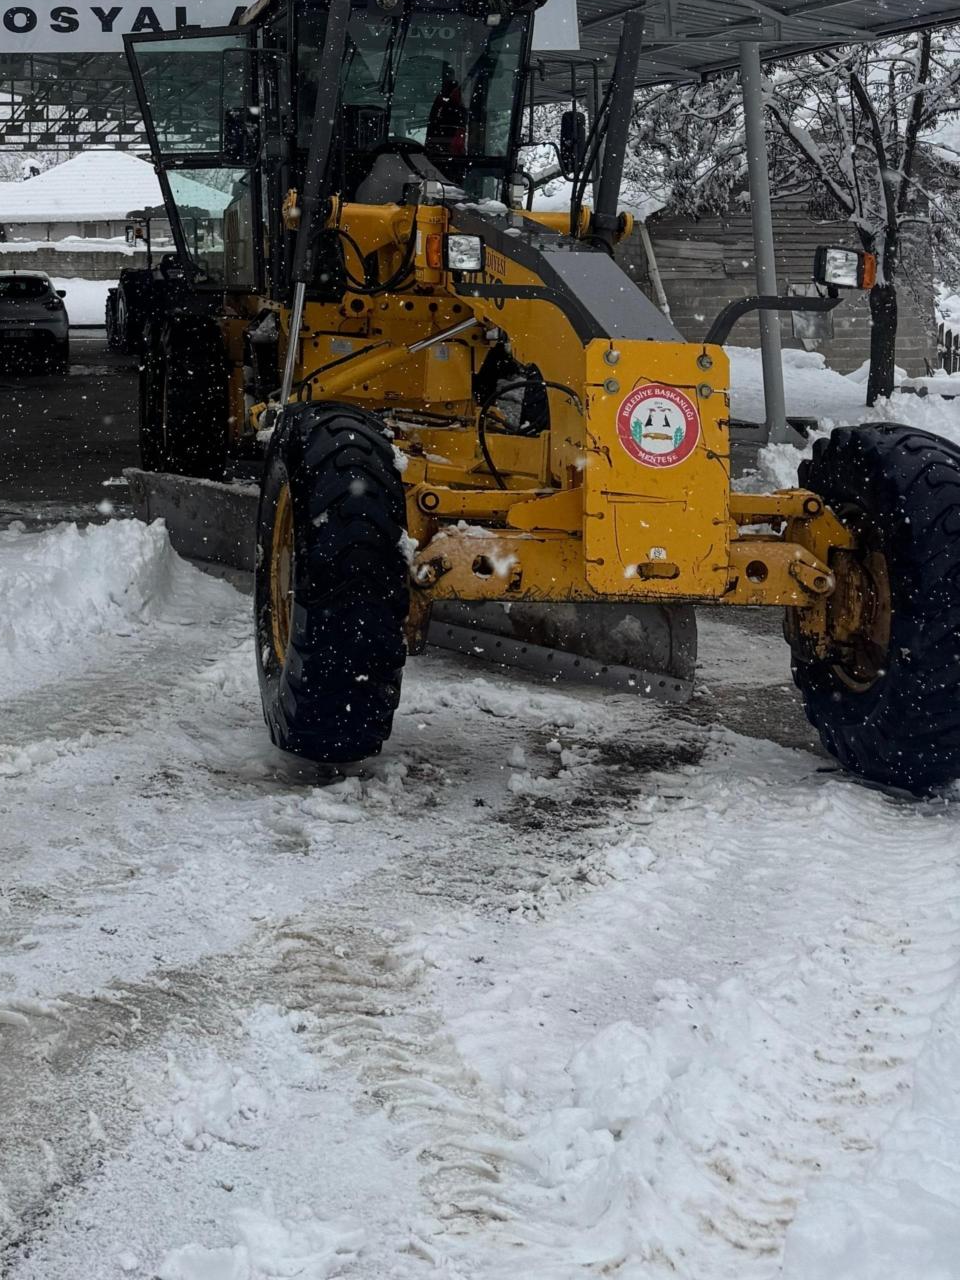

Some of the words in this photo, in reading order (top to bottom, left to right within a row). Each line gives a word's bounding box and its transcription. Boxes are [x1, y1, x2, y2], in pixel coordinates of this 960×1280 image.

[486, 250, 506, 276] DİYESİ
[623, 389, 654, 417] BELEDİYE
[638, 451, 679, 464] MENTEŞE
